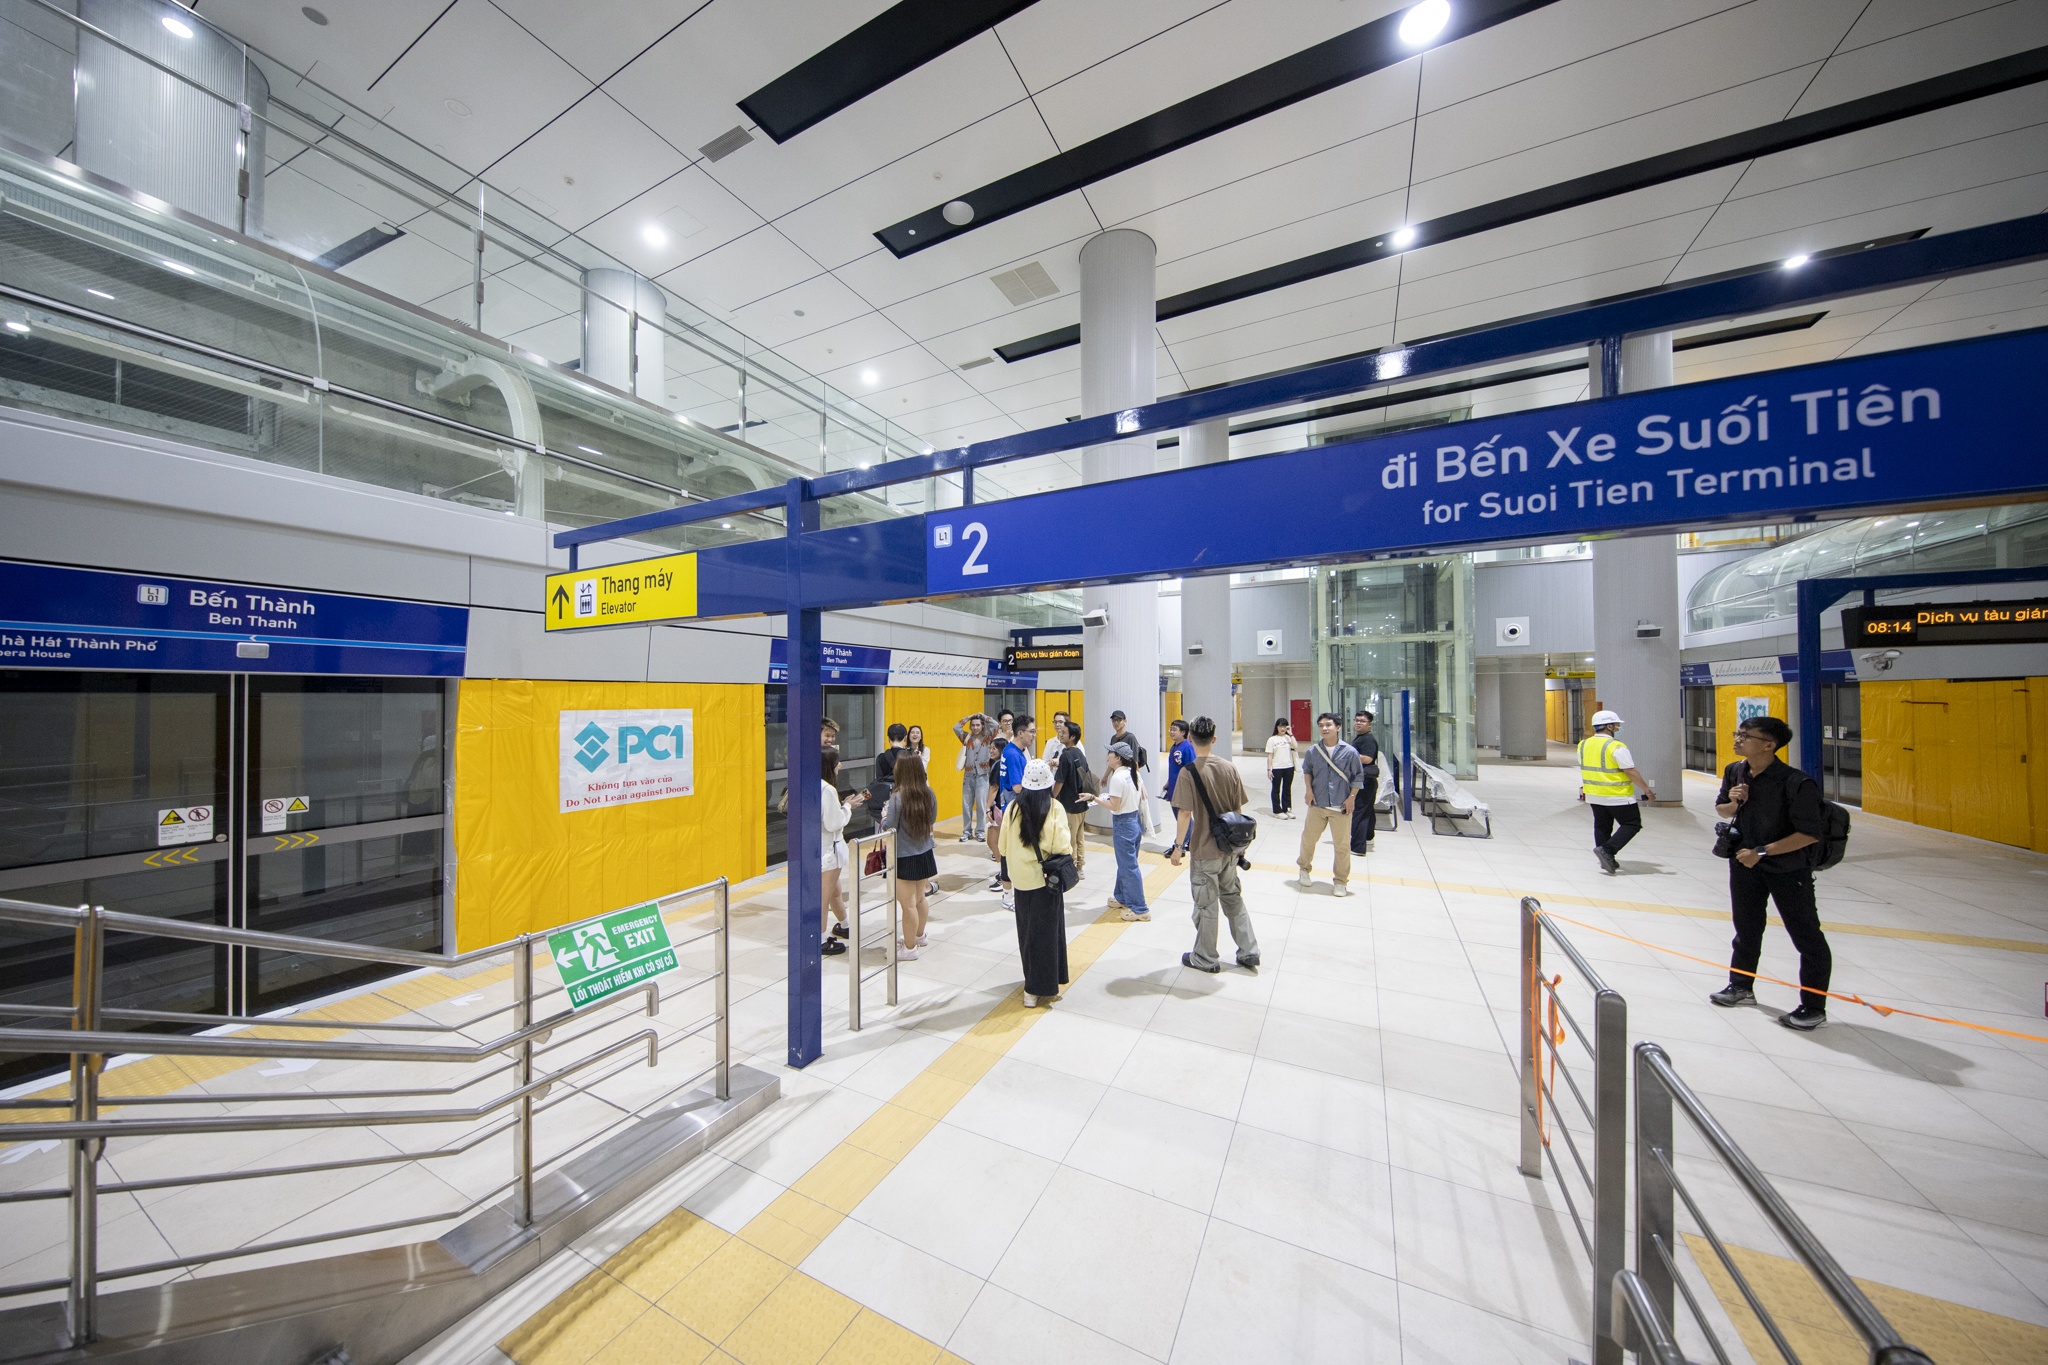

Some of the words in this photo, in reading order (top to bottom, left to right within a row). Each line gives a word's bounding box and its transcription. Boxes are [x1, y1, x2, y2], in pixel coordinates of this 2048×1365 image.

[1381, 453, 1417, 489] đi
[1436, 434, 1528, 483] Bến
[1546, 427, 1616, 469] Xe
[1636, 395, 1769, 457] Suối
[1791, 384, 1941, 435] Tiên
[1423, 500, 1467, 525] for
[1479, 486, 1557, 519] Suoi
[1569, 480, 1653, 509] Tien
[1667, 448, 1876, 498] Terminal
[939, 531, 948, 541] L1
[962, 522, 988, 576] 2
[602, 576, 640, 596] Thang
[644, 568, 673, 591] máy
[147, 587, 160, 595] L1
[190, 589, 238, 609] Bến
[245, 594, 316, 615] Thành
[601, 601, 637, 615] Elevator
[209, 613, 242, 626] Ben
[248, 616, 297, 629] Thanh
[1917, 611, 1954, 625] Dịch
[1960, 612, 1979, 622] vụ
[1984, 609, 2010, 621] tàu
[1867, 621, 1912, 634] 08:14
[1, 635, 25, 646] hà
[31, 636, 62, 648] Hát
[67, 637, 120, 650] Thành
[125, 640, 159, 651] Phố
[30, 650, 71, 659] House
[823, 647, 834, 655] Bến
[836, 648, 852, 657] Thành
[1008, 654, 1015, 665] 2
[1015, 651, 1030, 659] Dịch
[1049, 650, 1062, 659] gián
[618, 725, 683, 764] PC1
[587, 782, 620, 792] Không
[622, 780, 637, 789] tựa
[640, 777, 655, 785] vào
[657, 774, 673, 784] cửa
[566, 799, 580, 808] Do
[583, 796, 601, 806] Not
[605, 793, 628, 802] Lean
[630, 788, 663, 799] against
[665, 785, 690, 794] Doors
[612, 914, 657, 934] EMERGENCY
[624, 927, 657, 949] EXIT
[573, 985, 588, 1003] LỐI
[588, 976, 613, 998] THOÁT
[613, 968, 633, 986] HIỂM
[633, 965, 645, 979] KHI
[646, 960, 655, 973] CÓ
[656, 957, 664, 971] SỰ
[665, 952, 674, 965] CỐ
